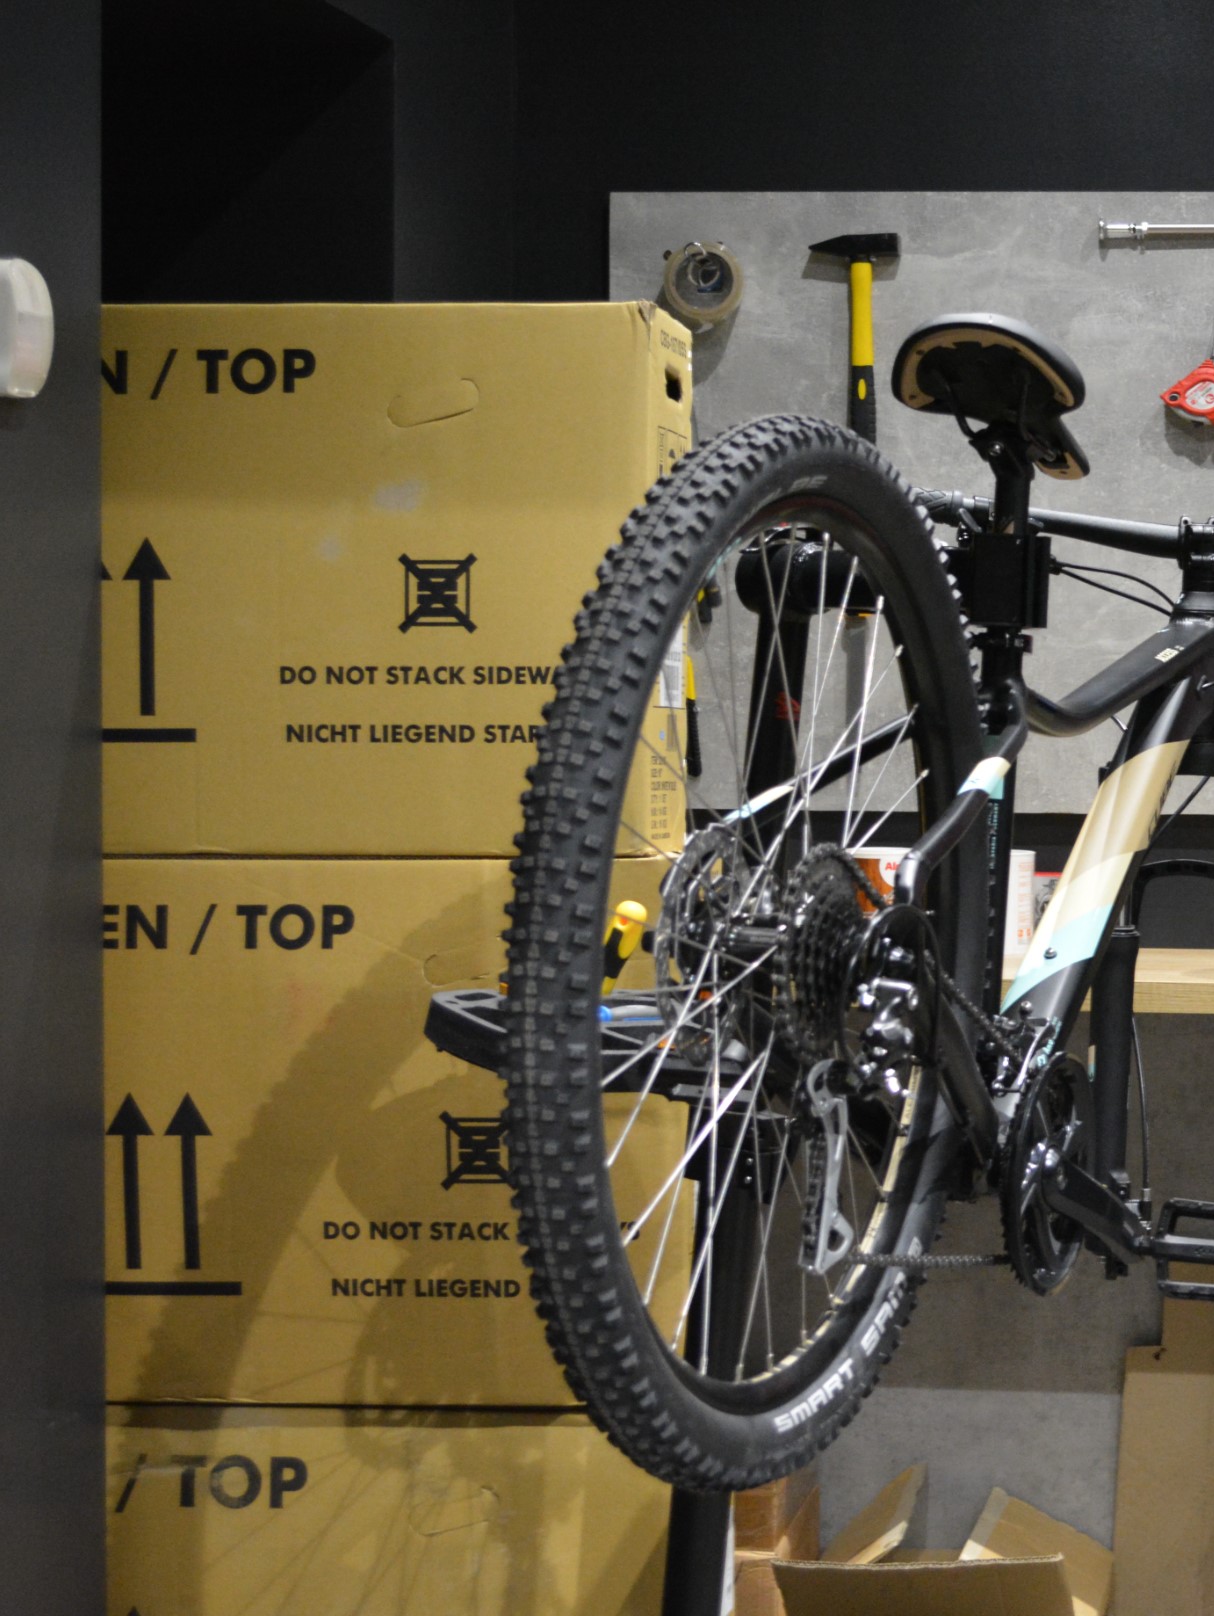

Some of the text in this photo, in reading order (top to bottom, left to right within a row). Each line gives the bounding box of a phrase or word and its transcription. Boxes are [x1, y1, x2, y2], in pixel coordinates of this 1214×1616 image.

[150, 348, 178, 400] /
[196, 348, 316, 395] TOP
[279, 665, 317, 686] DO
[325, 665, 378, 686] NOT
[385, 665, 466, 686] STACK
[285, 723, 362, 744] NICHT
[369, 723, 476, 744] LIEGEND
[189, 903, 217, 955] /
[236, 903, 356, 950] TOP
[323, 1221, 511, 1242] DO NOT STACK
[331, 1278, 521, 1299] NICHT LIEGEND
[773, 1357, 855, 1434] SMART
[114, 1453, 309, 1513] / TOP
